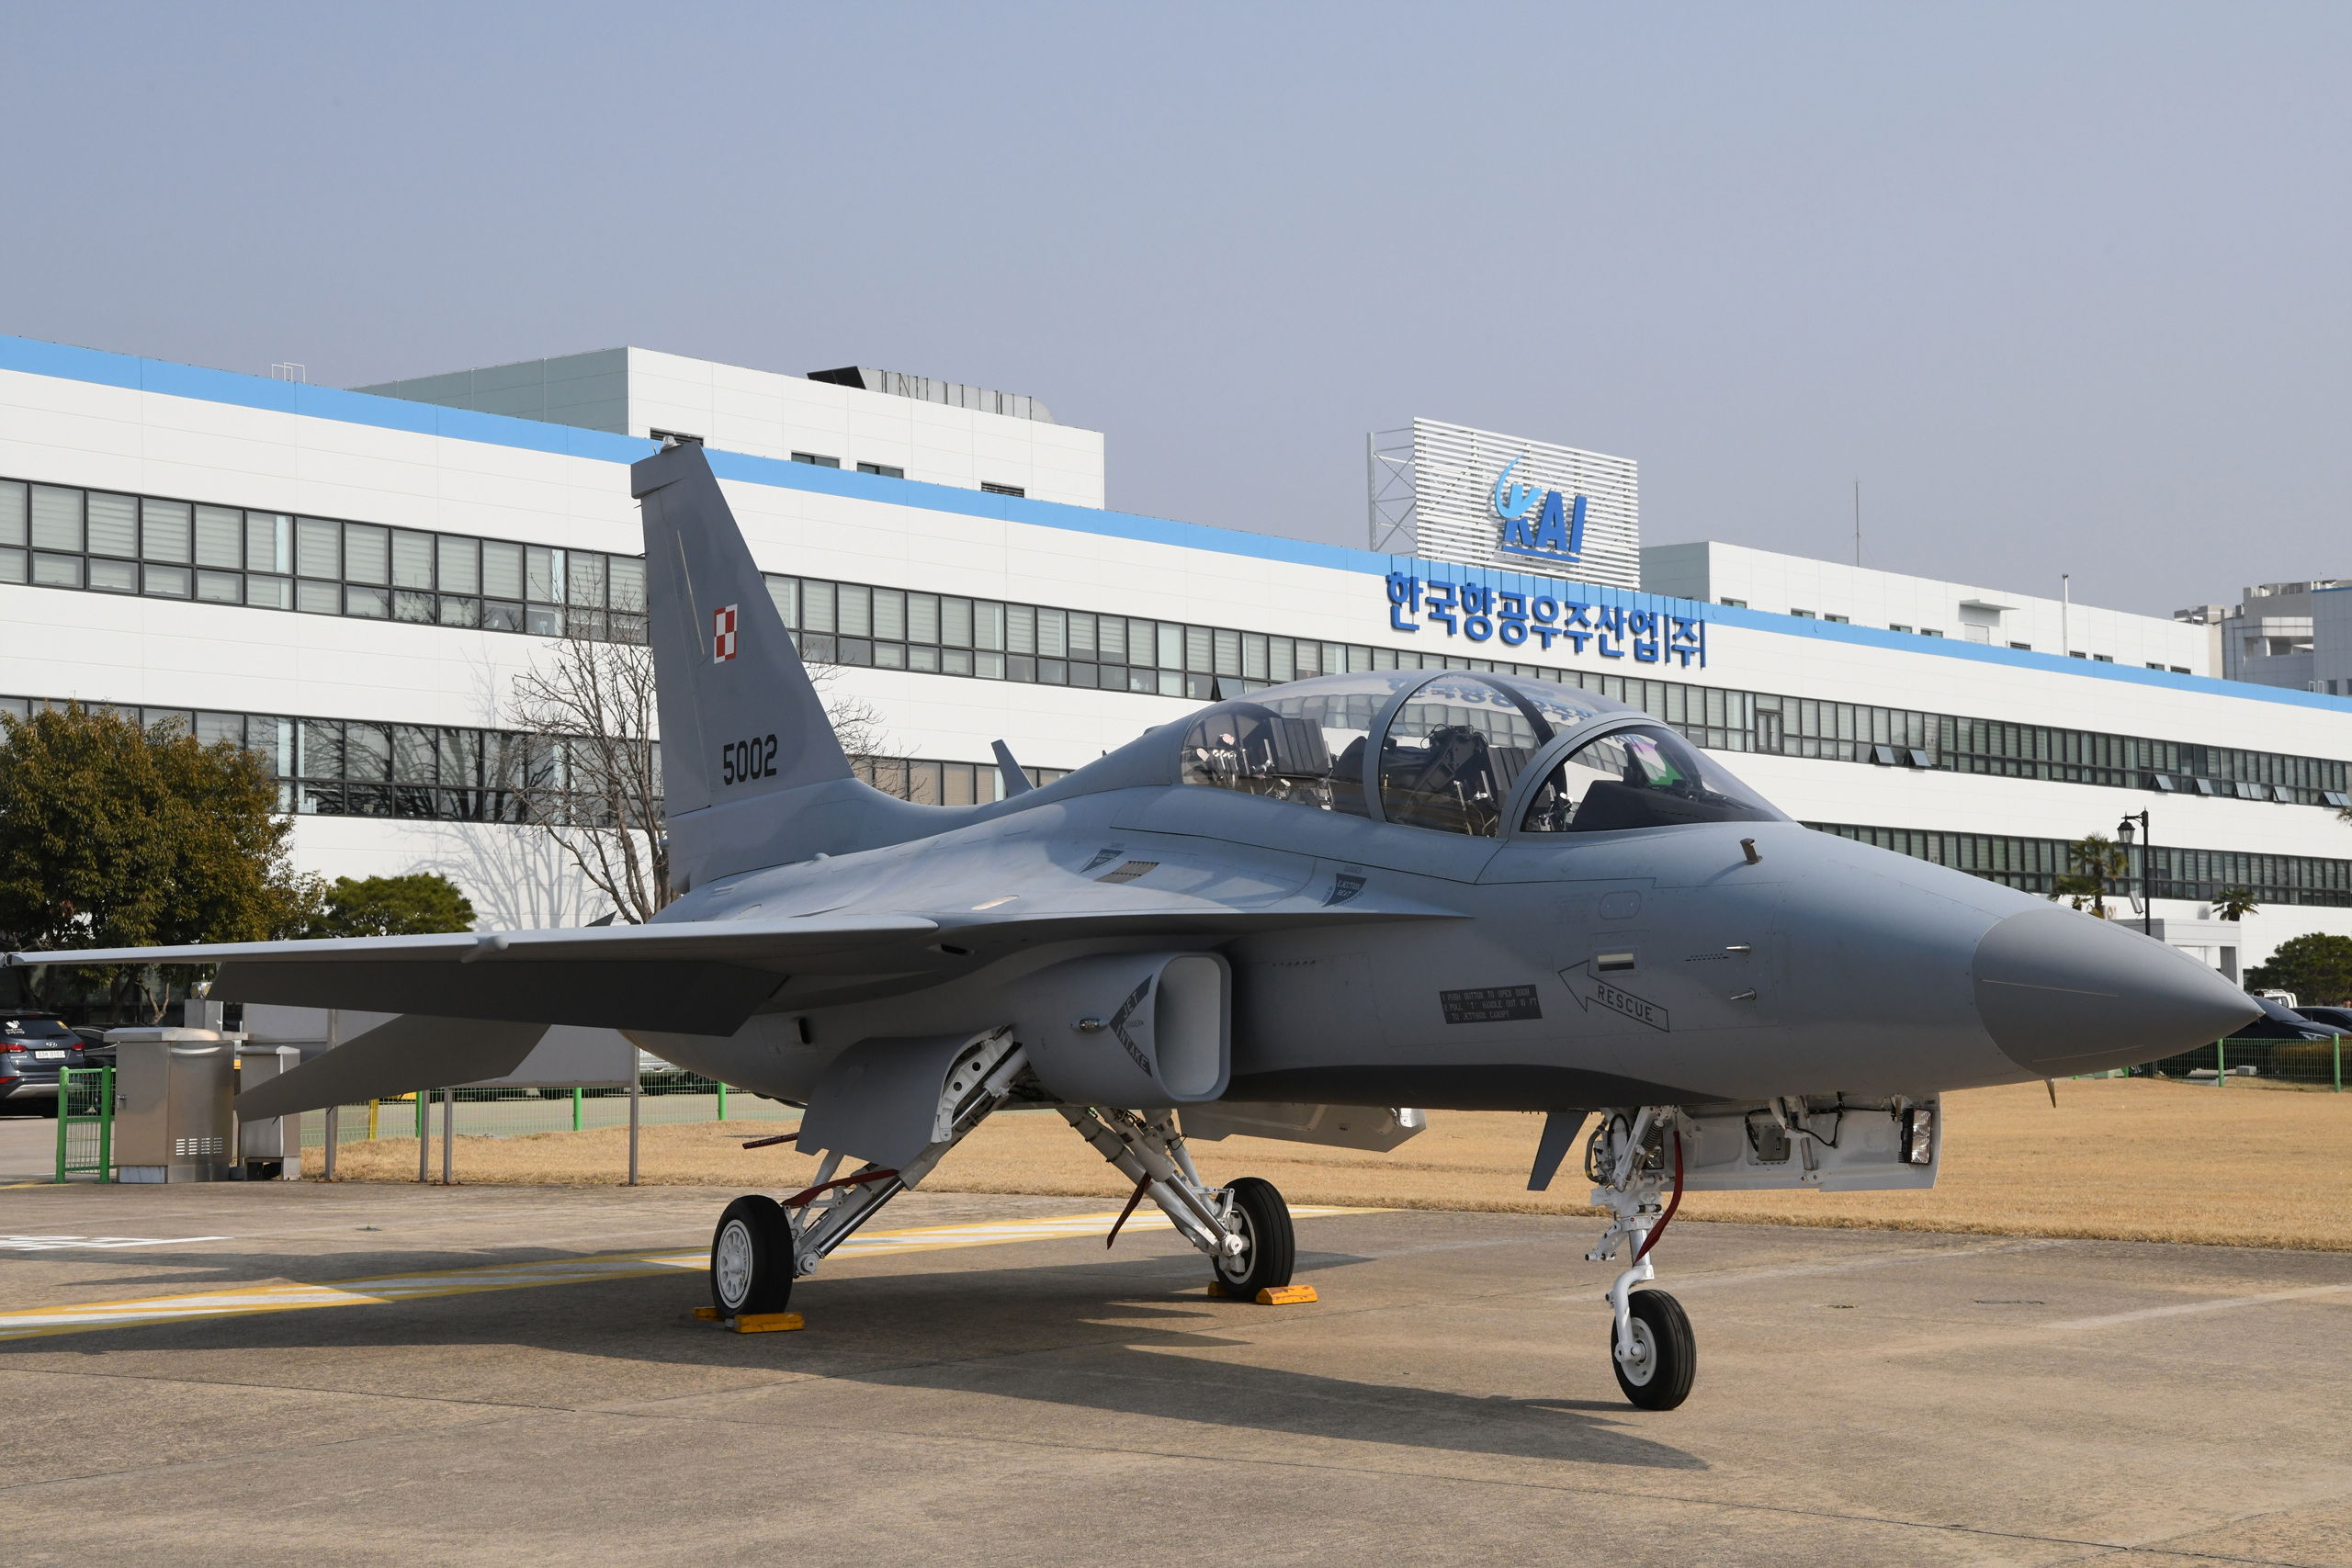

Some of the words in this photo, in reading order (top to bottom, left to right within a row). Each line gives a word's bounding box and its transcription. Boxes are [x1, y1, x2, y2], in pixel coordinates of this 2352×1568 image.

[1494, 456, 1588, 555] KAI
[723, 734, 777, 785] 5002
[1123, 991, 1139, 1020] JET
[1449, 1002, 1464, 1011] PULL
[1482, 999, 1503, 1010] HANDLE
[1505, 998, 1516, 1008] OUT
[1529, 997, 1537, 1007] FT
[1464, 992, 1484, 1000] BUTTON
[1487, 990, 1495, 999] TO
[1498, 989, 1513, 998] OPEN
[1598, 984, 1654, 1021] RESCUE
[1452, 1013, 1460, 1022] TO
[1488, 1010, 1510, 1020] CANOPY
[1116, 1023, 1148, 1071] INTAKE
